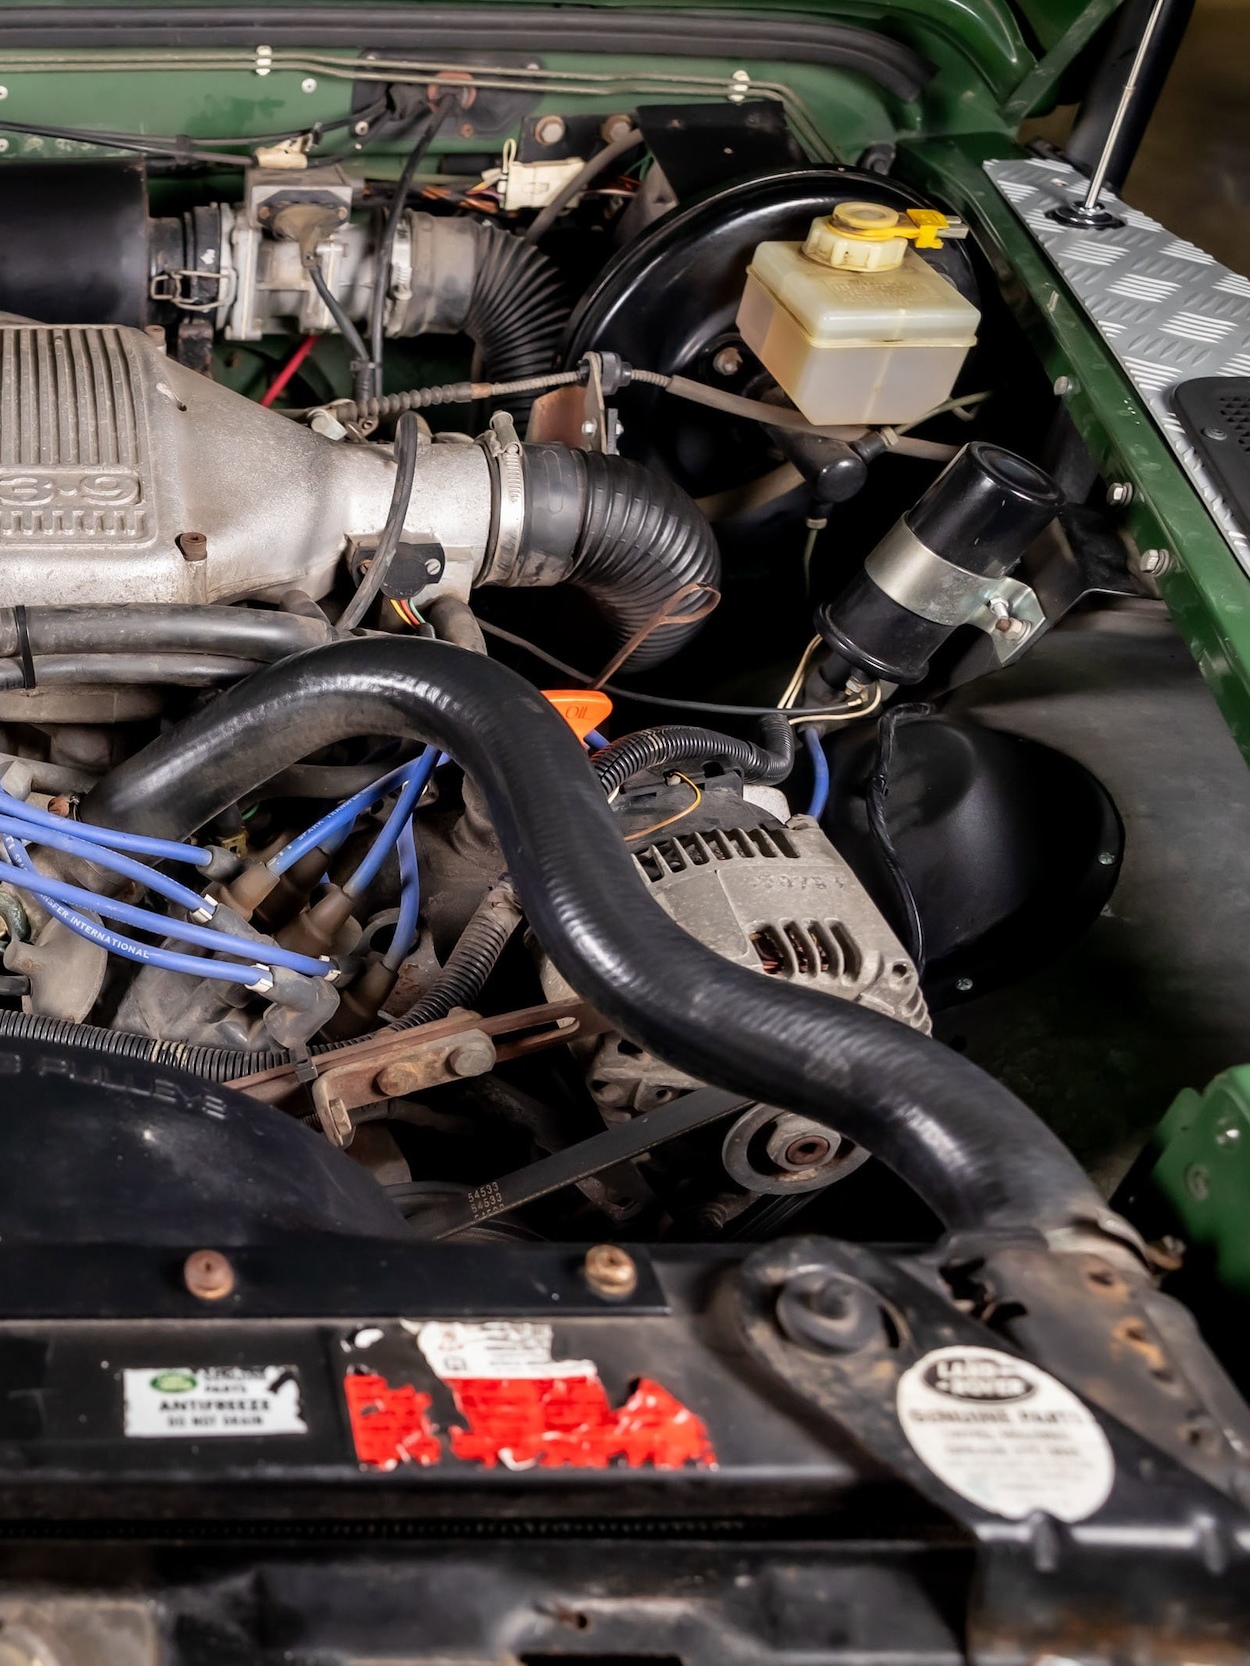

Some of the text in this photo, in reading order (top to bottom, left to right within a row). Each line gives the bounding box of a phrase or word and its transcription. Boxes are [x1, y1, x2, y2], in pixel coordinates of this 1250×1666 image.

[566, 706, 592, 720] OIL
[70, 916, 149, 959] INTERNATIONAL
[468, 1181, 499, 1202] 54533
[471, 1192, 503, 1213] 54533
